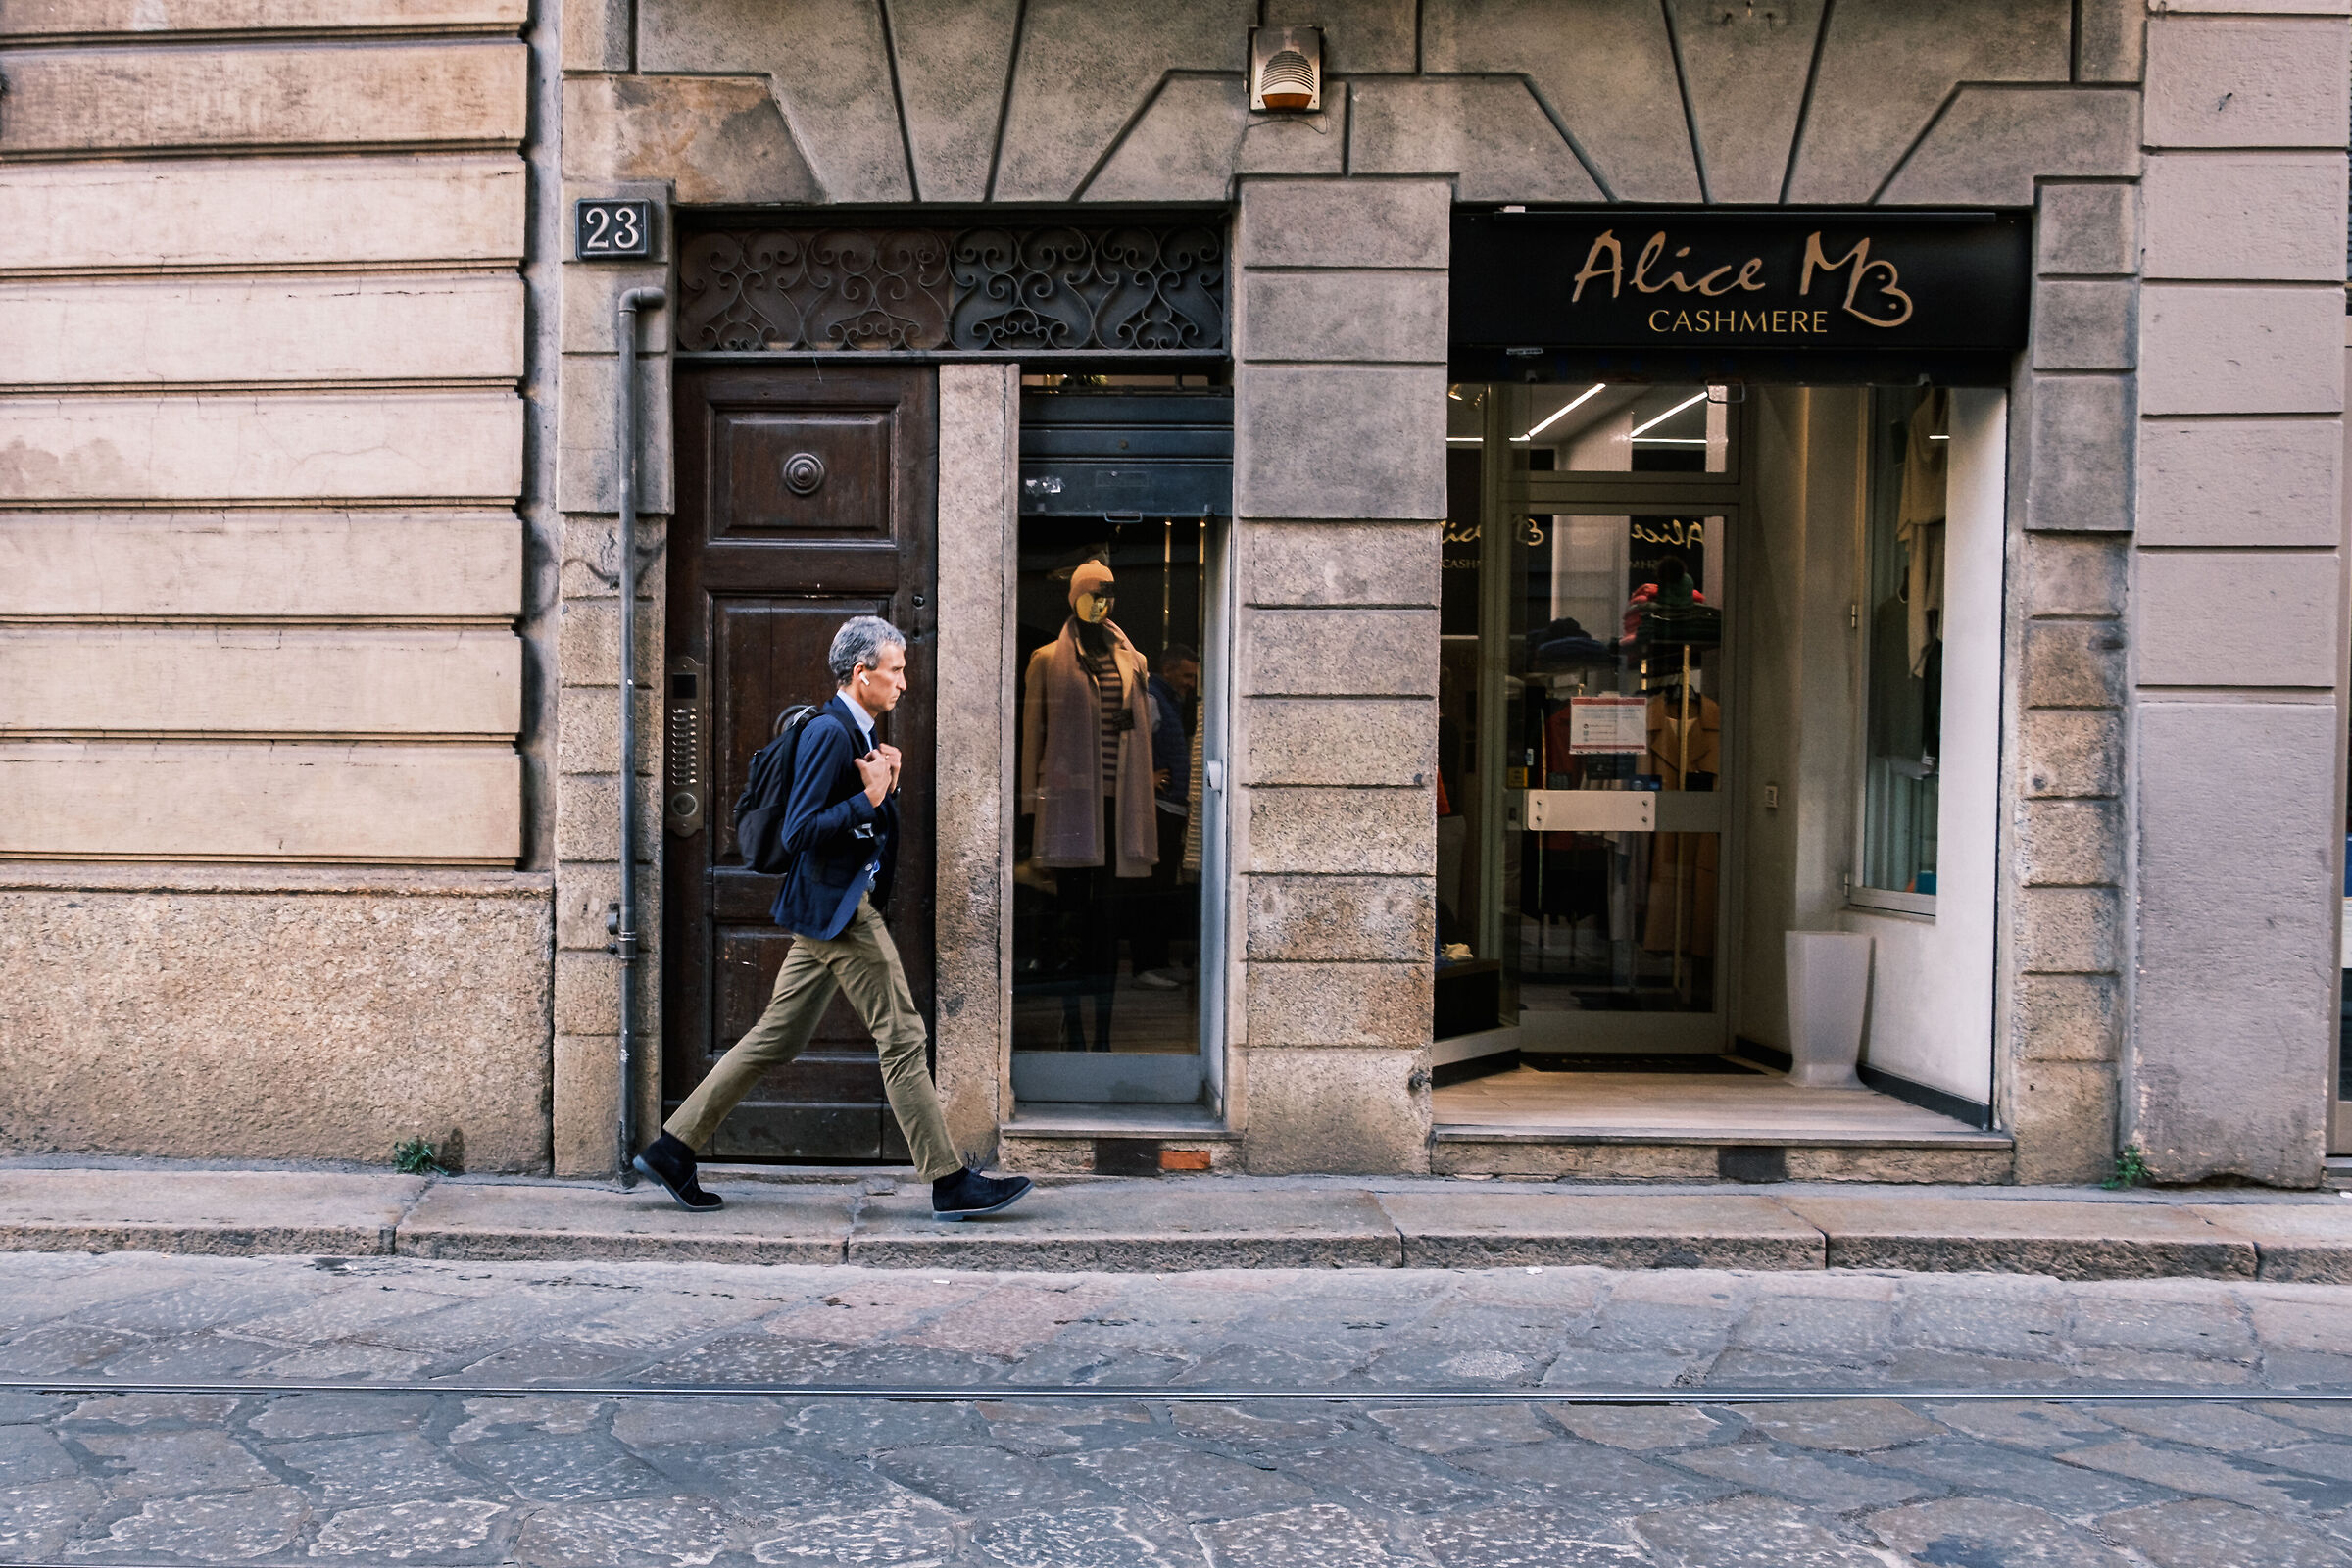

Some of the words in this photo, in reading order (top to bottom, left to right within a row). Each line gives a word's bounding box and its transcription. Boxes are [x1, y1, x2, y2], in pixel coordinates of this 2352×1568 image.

[585, 207, 639, 249] 23
[1571, 229, 1766, 303] Alice
[1648, 309, 1828, 333] CASHMERE
